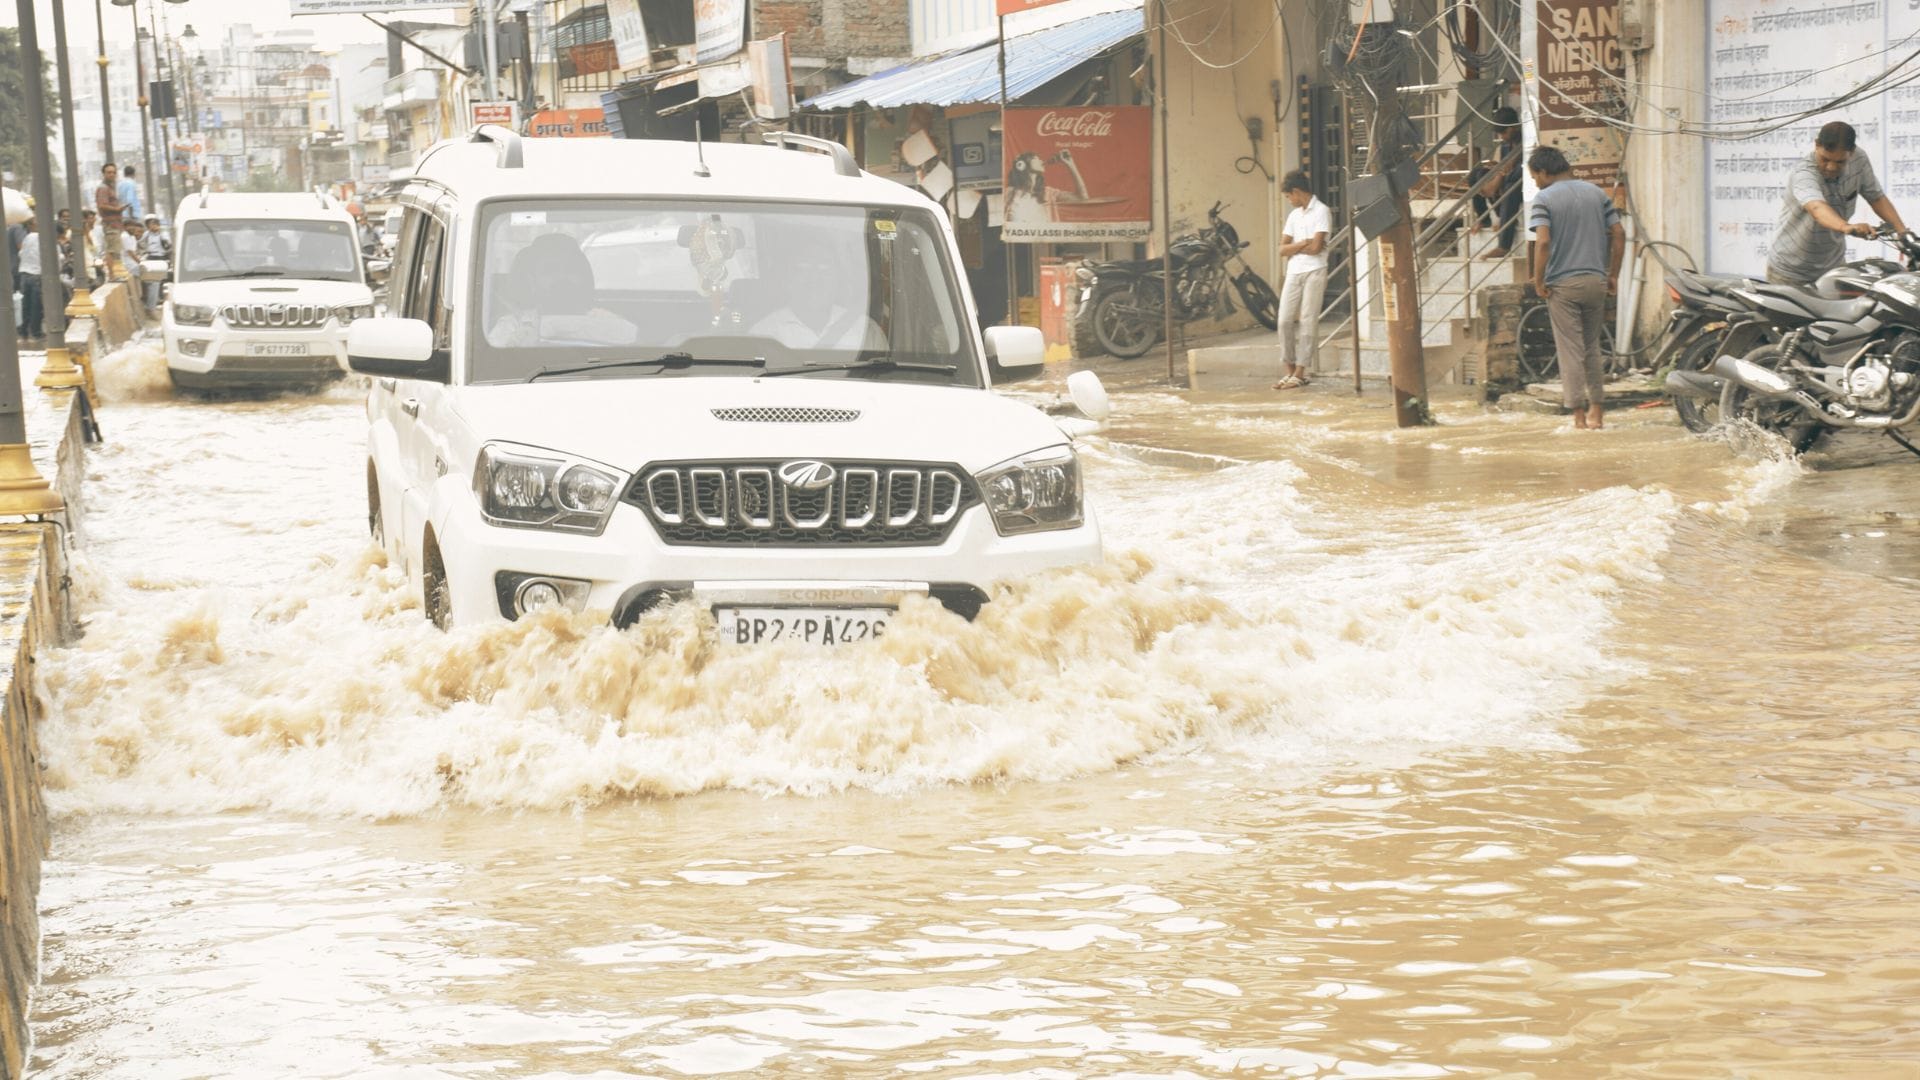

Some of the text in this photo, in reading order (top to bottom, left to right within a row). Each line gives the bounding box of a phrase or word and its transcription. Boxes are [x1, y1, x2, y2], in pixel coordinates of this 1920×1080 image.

[1547, 40, 1624, 73] MEDIC
[1037, 111, 1116, 137] Coca-Cola
[1005, 228, 1035, 237] YADAV
[1037, 228, 1061, 237] LASSI
[1063, 228, 1105, 237] BHANDAR
[1108, 228, 1127, 237] AND
